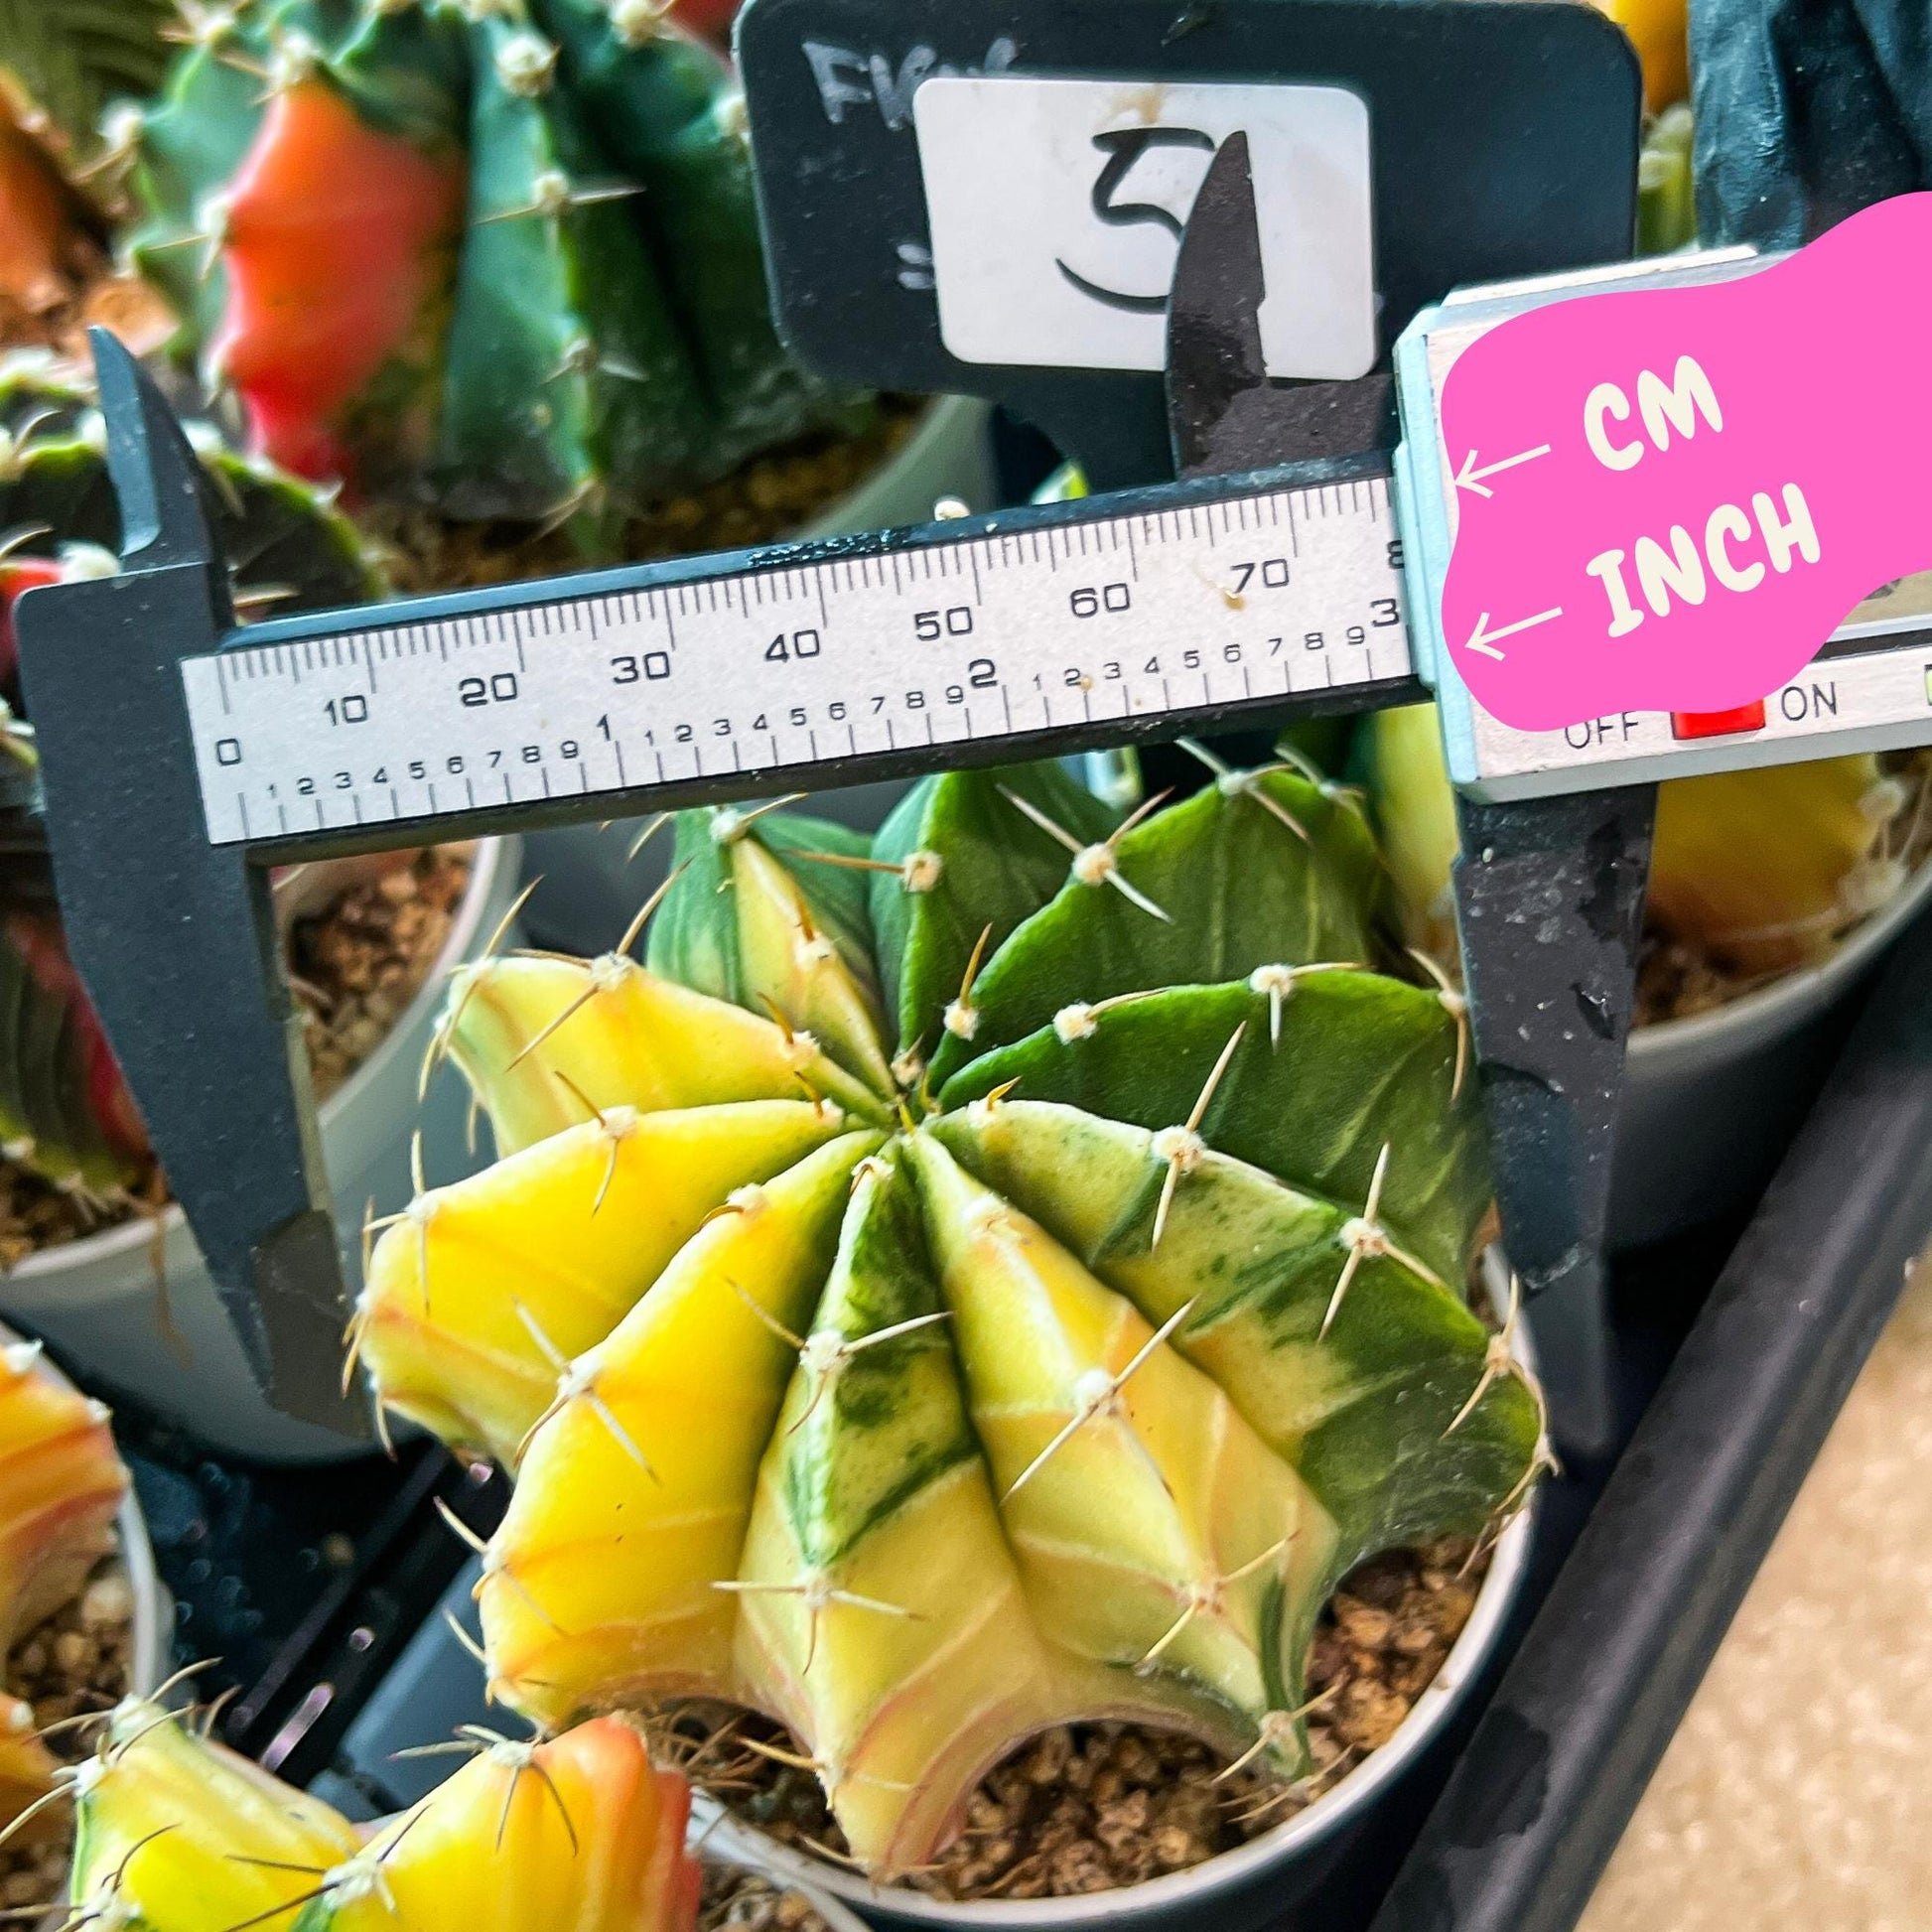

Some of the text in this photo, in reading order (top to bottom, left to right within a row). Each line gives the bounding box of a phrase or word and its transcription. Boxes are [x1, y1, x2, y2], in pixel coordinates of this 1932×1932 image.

[215, 738, 241, 766] 0
[324, 694, 367, 727] 10
[459, 673, 517, 707] 20
[611, 651, 670, 684] 30
[764, 629, 820, 663] 40
[914, 607, 973, 641] 50
[1071, 582, 1130, 619] 60
[1230, 558, 1290, 594] 70
[268, 598, 1401, 797] 1 2 3 4 5 6 7 8 9 1 1 2 3 4 5 6 7 8 9 2 1 2 3 4 5 6 7 8 9 3
[1565, 681, 1837, 750] OFF ON
